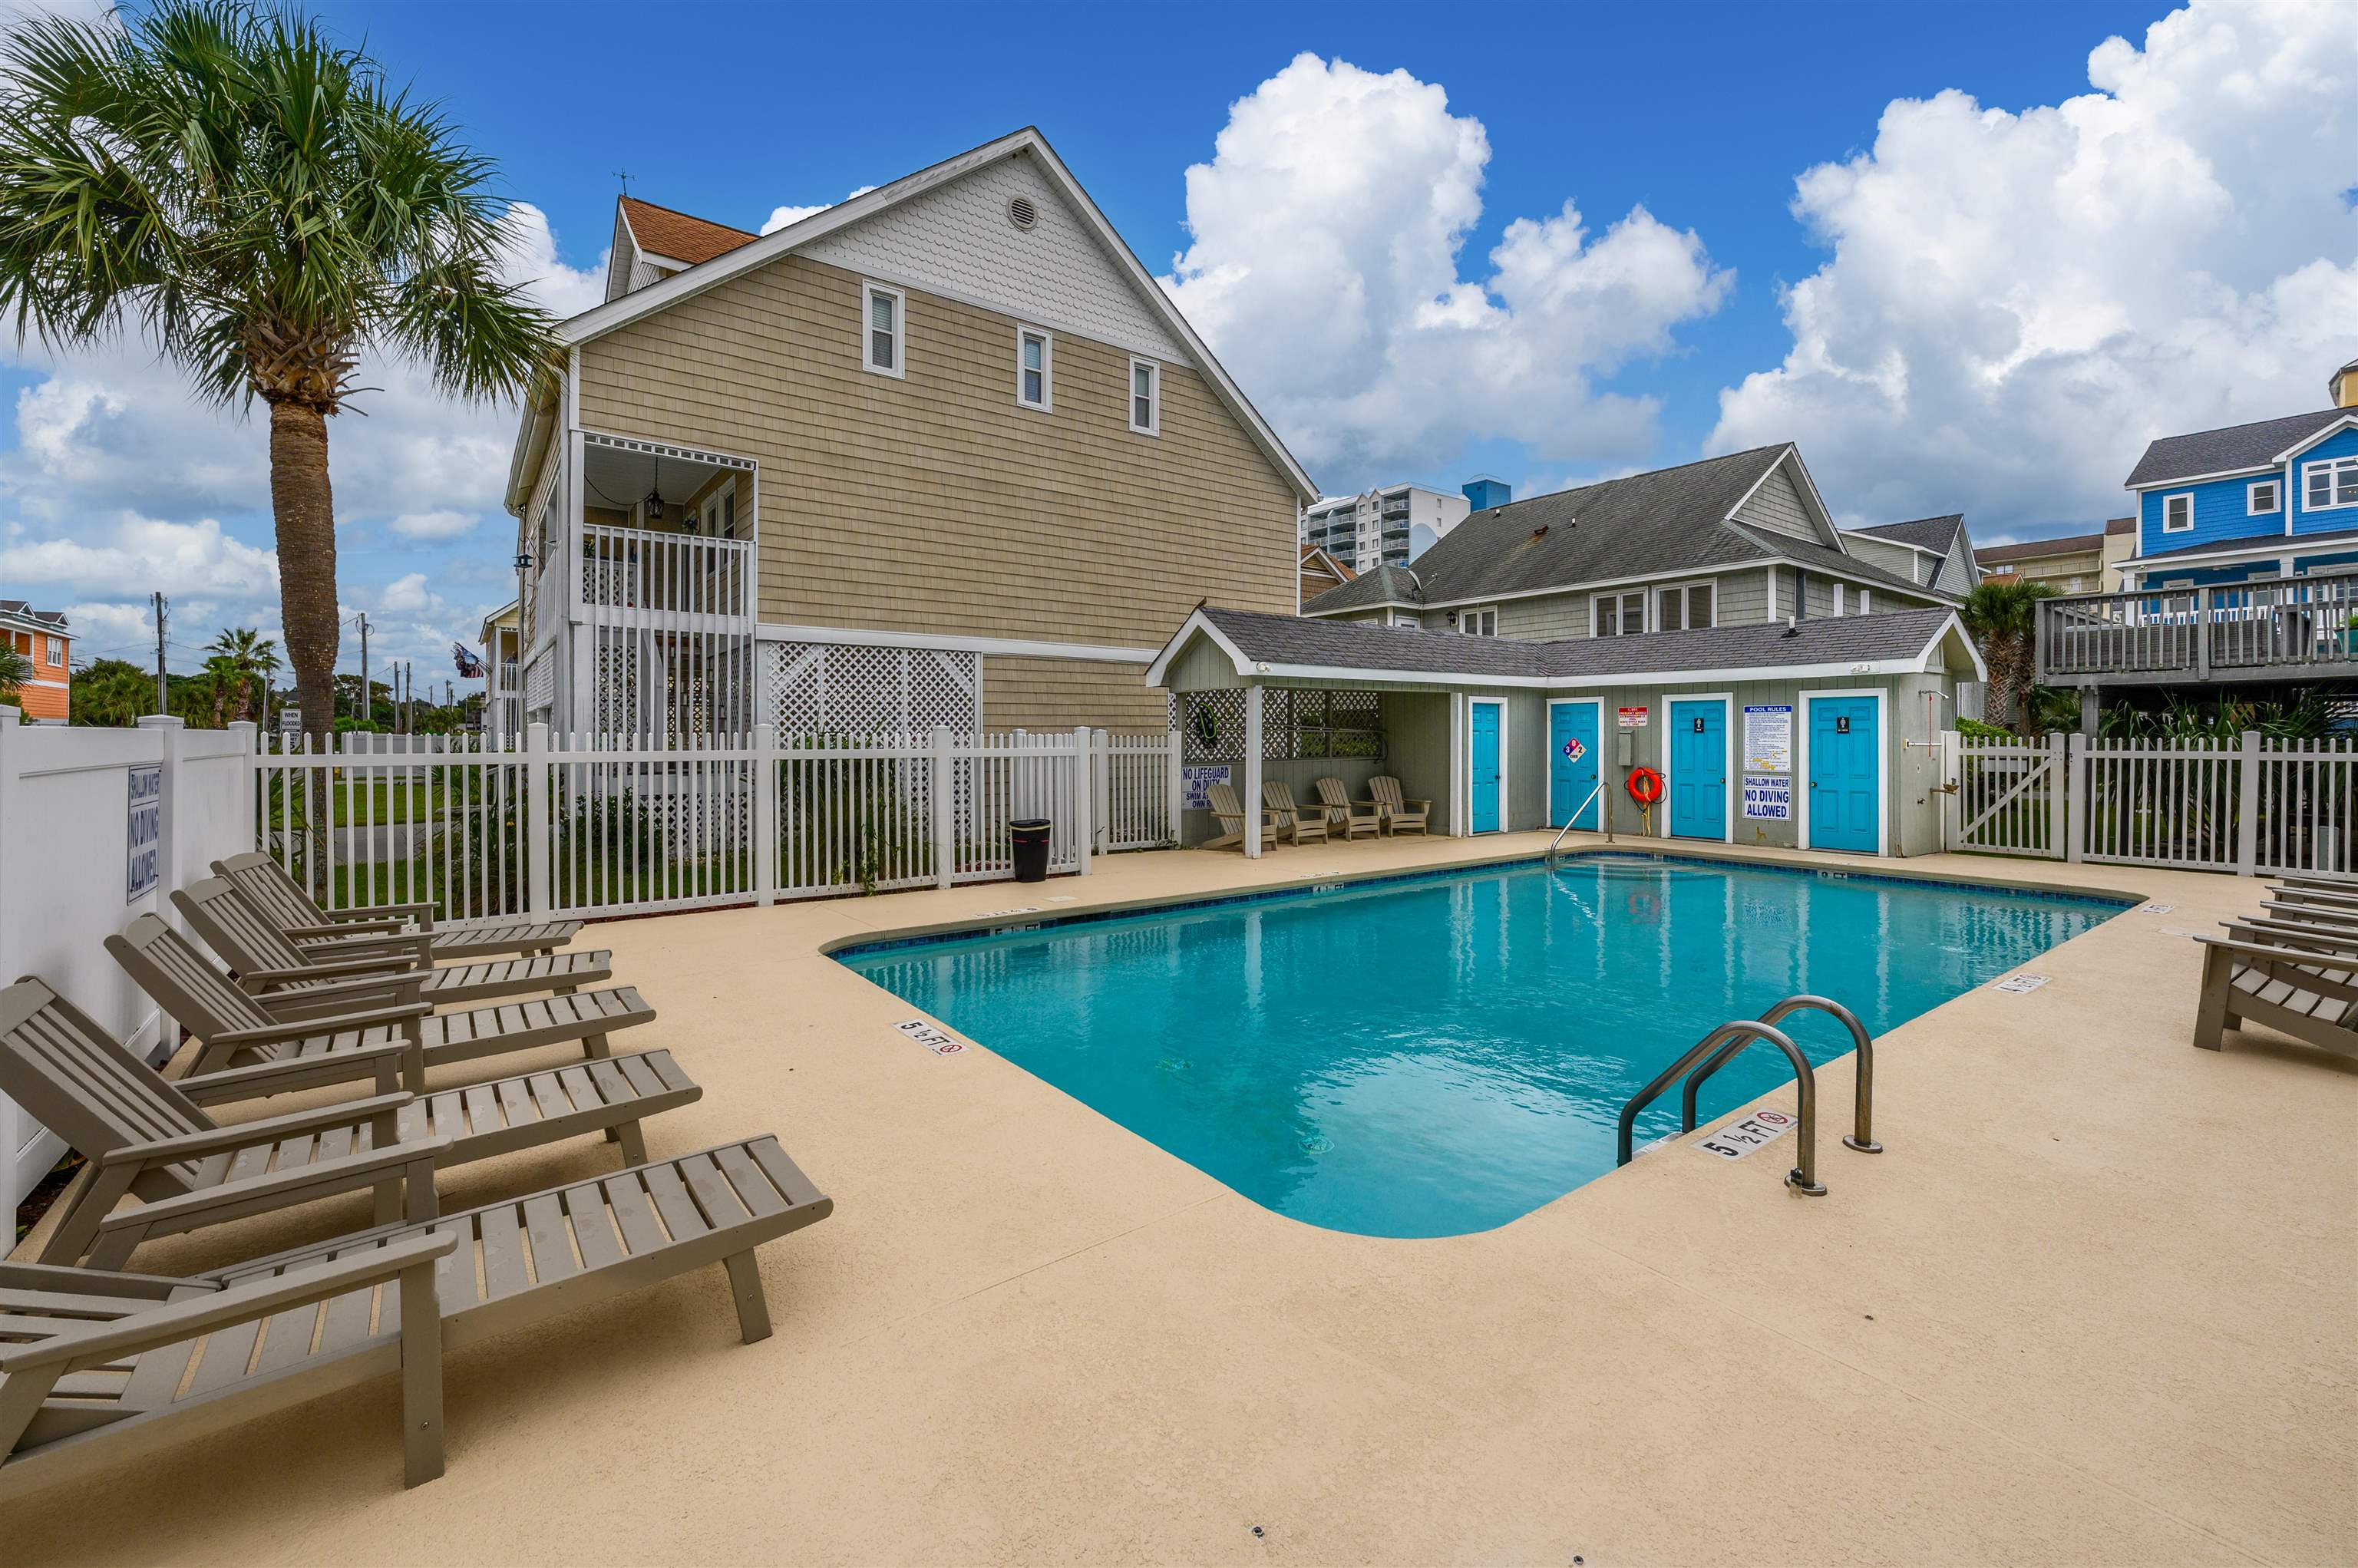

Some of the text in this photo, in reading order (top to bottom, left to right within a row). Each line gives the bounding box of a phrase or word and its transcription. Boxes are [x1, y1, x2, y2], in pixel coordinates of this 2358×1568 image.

[1183, 767, 1229, 780] NO LIFEGUARD
[1192, 780, 1201, 791] ON
[1745, 777, 1789, 787] SHALLOW WATER
[1187, 792, 1200, 801] SWIM
[1745, 790, 1789, 804] NO DIVING
[1746, 804, 1787, 818] ALLOWED
[130, 807, 159, 849] NO DIVING
[132, 849, 157, 893] ALLOWED
[900, 1022, 924, 1030] 5
[920, 1035, 952, 1046] FT
[1702, 1141, 1739, 1157] 5
[1737, 1120, 1779, 1138] FT
